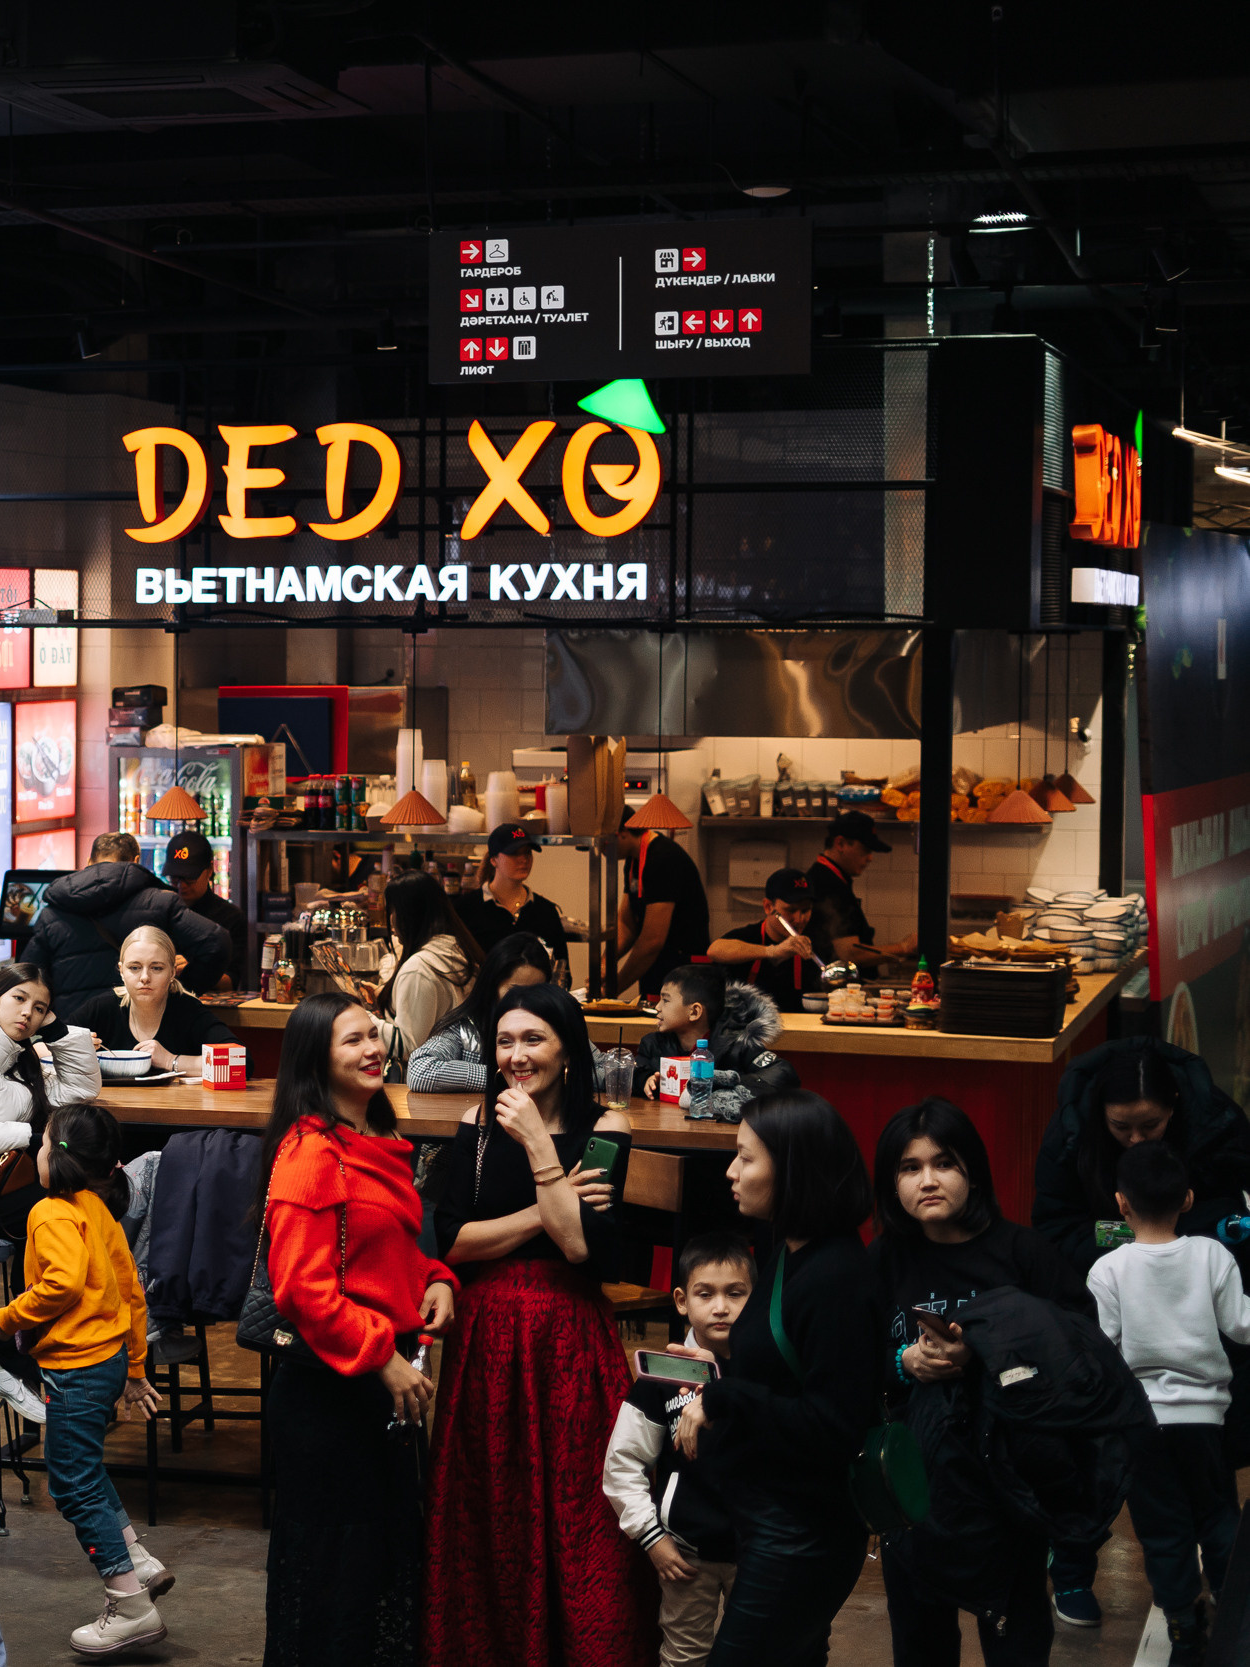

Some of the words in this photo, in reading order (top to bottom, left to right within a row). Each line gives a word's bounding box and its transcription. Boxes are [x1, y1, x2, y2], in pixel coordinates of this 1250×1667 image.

[460, 266, 521, 278] ГАРДЕРОБ
[655, 275, 721, 288] ДҮКЕНДЕР
[732, 273, 775, 284] ЛАВКИ
[460, 314, 532, 327] ДӘРЕТХАНА
[543, 312, 589, 323] ТУАЛЕТ
[655, 338, 693, 350] ШЫҒУ
[705, 337, 750, 348] ВЫХОД
[460, 365, 494, 376] ЛИФТ
[123, 422, 403, 544] DED
[136, 566, 468, 603] ВЬЕТНАМСКАЯ
[489, 563, 647, 600] КУХНЯ
